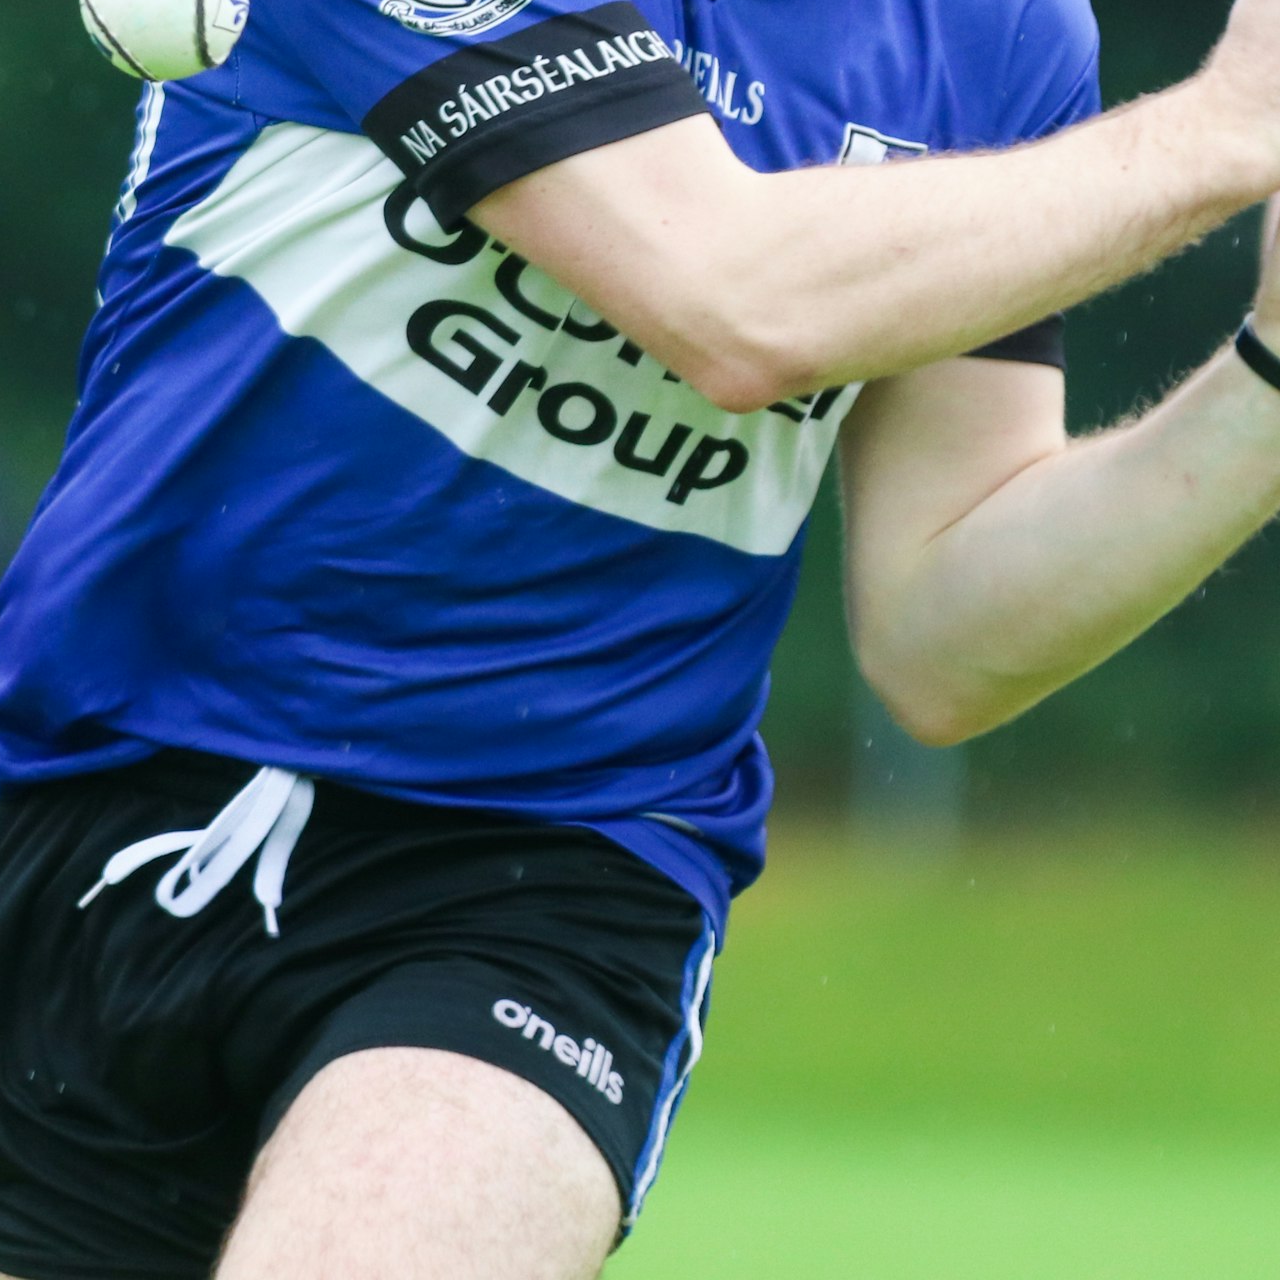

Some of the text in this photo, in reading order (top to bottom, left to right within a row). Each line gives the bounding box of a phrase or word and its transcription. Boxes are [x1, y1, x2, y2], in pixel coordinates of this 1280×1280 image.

[400, 29, 676, 166] NA SÁIRSÉALAIGH
[406, 298, 750, 507] Group
